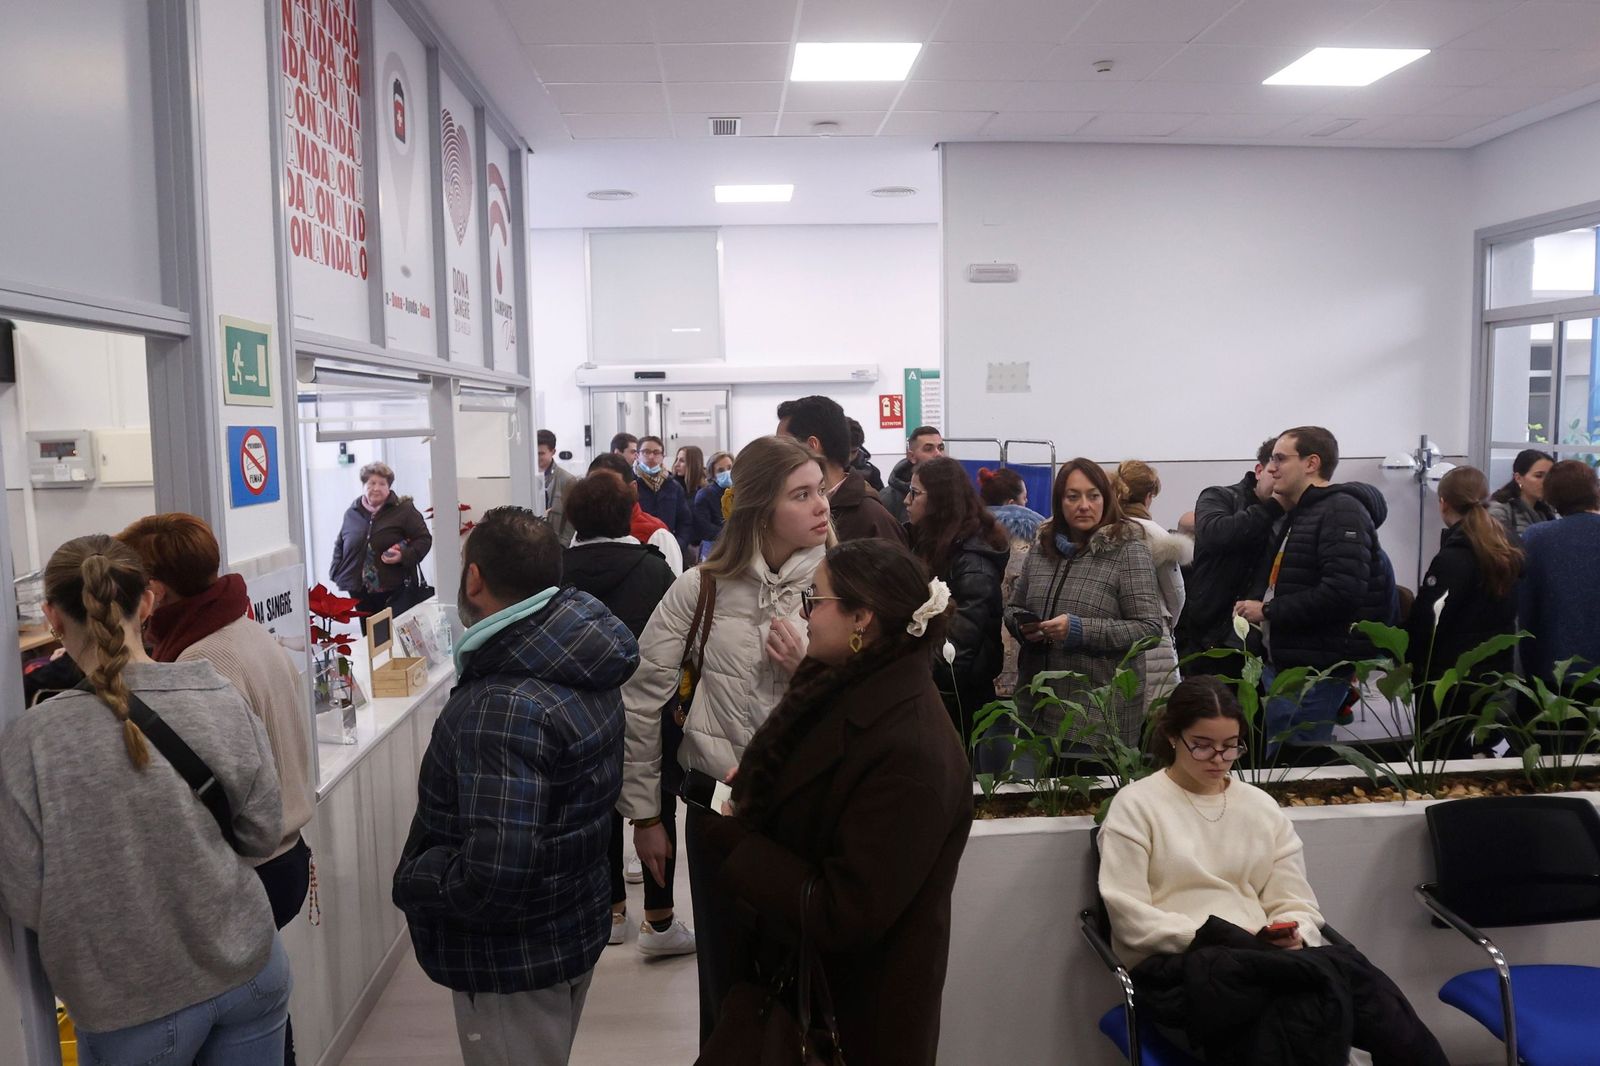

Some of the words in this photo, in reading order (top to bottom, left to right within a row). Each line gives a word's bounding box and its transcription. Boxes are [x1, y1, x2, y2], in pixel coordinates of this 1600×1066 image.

[452, 267, 470, 299] DONA
[250, 474, 263, 483] FUMAR
[266, 591, 292, 622] SANGRE
